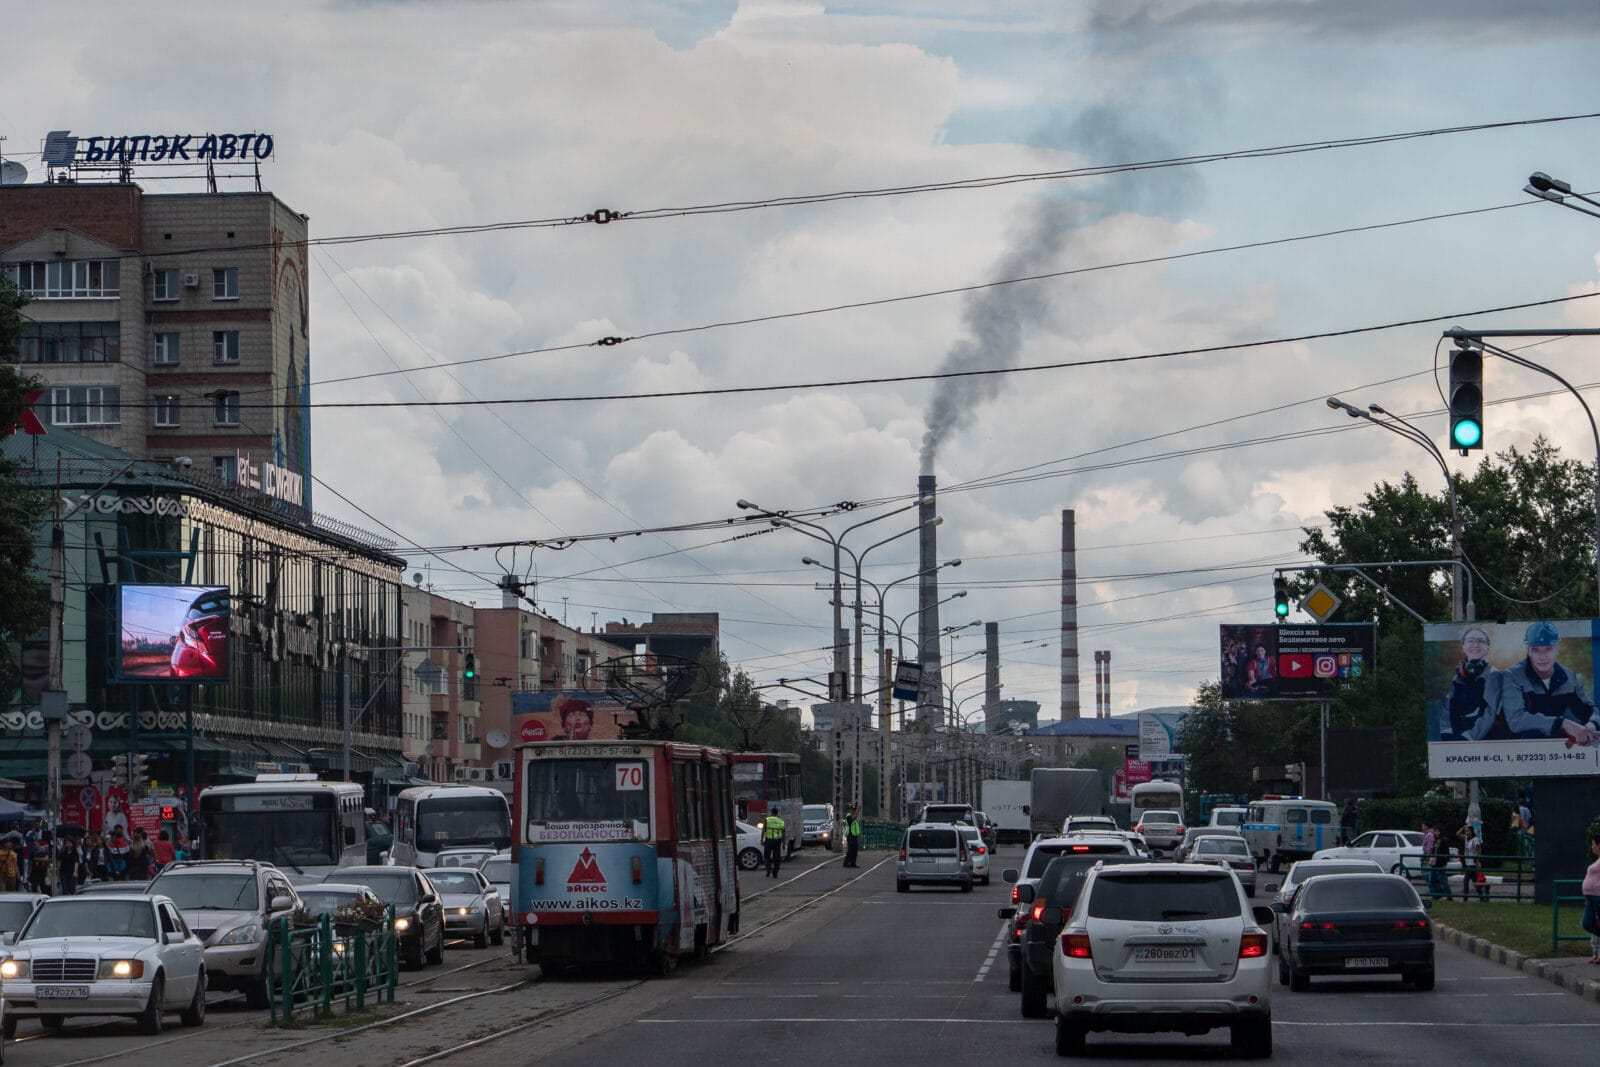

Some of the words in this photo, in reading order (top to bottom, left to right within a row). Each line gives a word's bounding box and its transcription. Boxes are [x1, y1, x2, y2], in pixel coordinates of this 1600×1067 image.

[85, 133, 193, 162] БИПЭК
[198, 132, 273, 160] АВТО
[1507, 755, 1514, 763] 1,
[1516, 753, 1546, 762] 8(7232)
[618, 767, 642, 786] 70
[539, 830, 628, 840] БЕЗОПАСНОСТЬ
[533, 897, 642, 909] www.aikos.kz
